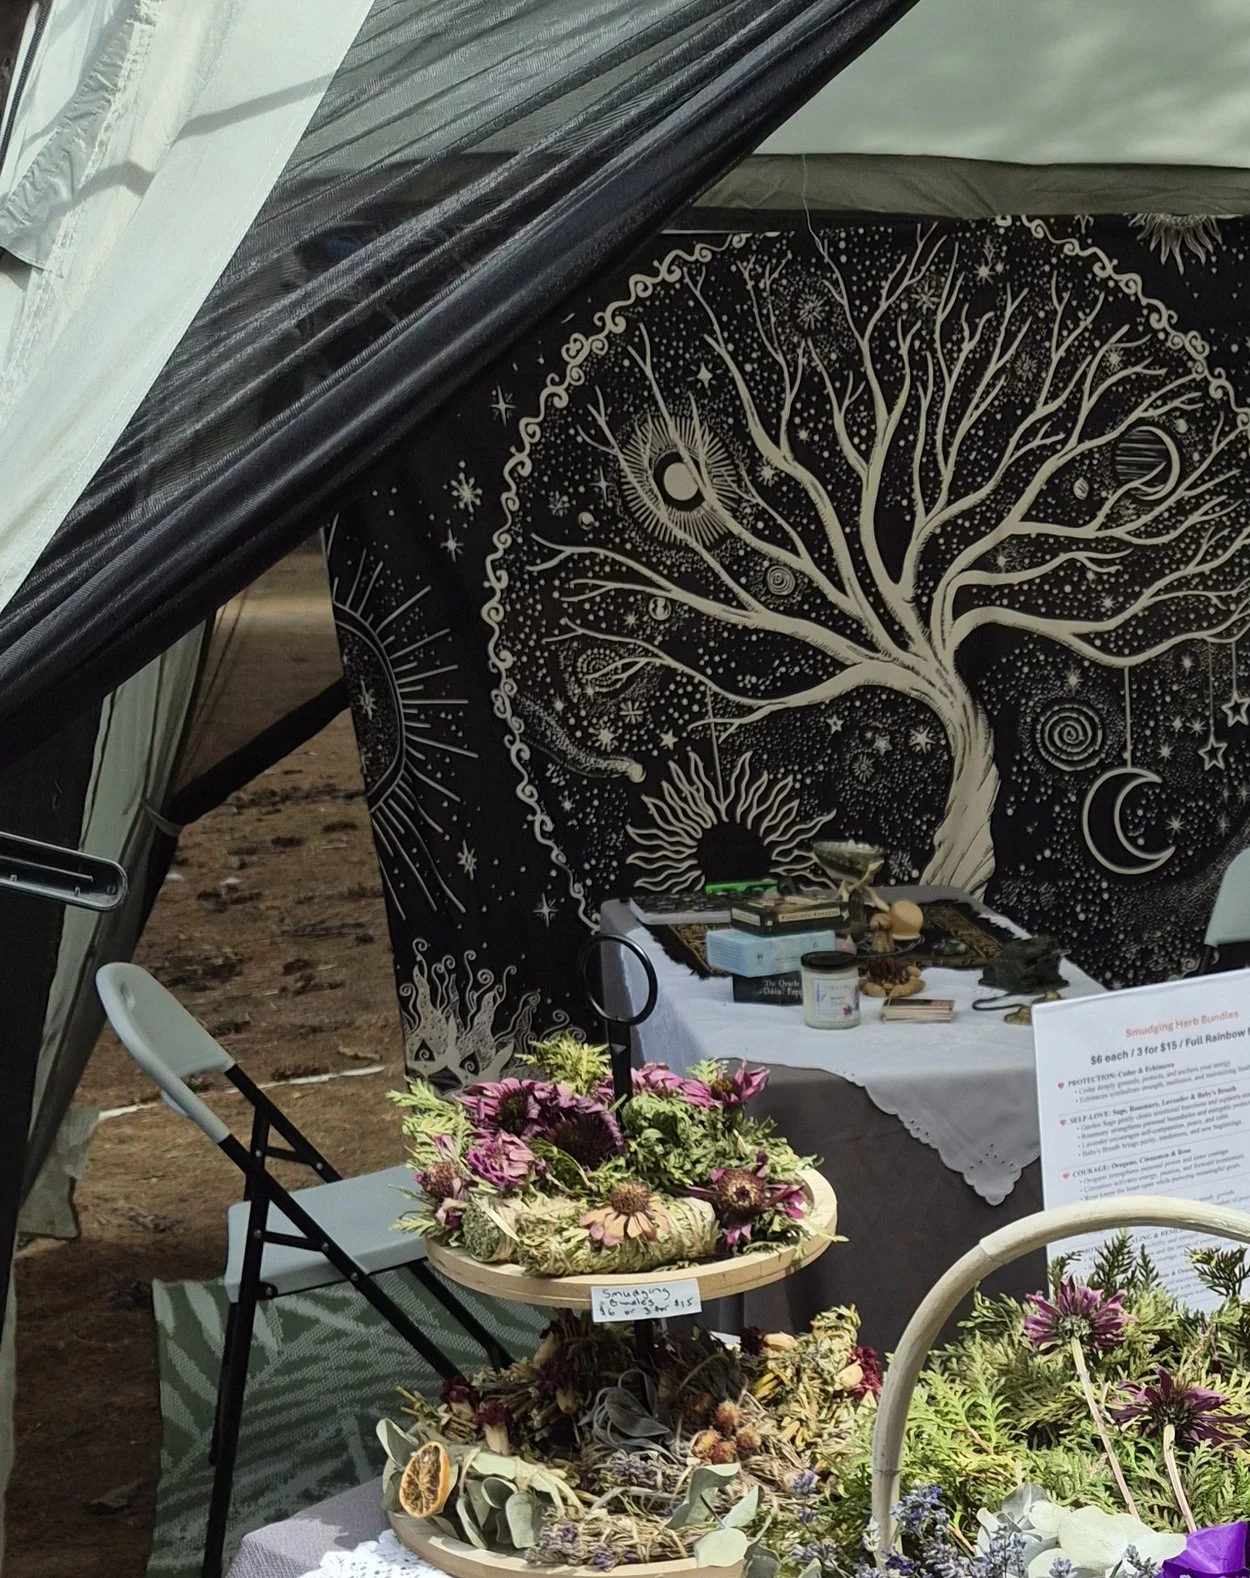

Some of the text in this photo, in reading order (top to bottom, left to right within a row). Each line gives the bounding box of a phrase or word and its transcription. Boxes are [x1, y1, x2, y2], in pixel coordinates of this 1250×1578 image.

[1125, 1010, 1239, 1038] Smudging Herb Bundles
[1090, 1054, 1103, 1066] $6
[1105, 1050, 1129, 1063] each
[1145, 1043, 1159, 1056] for
[1160, 1040, 1178, 1053] $15
[1185, 1034, 1203, 1048] Full
[1205, 1029, 1246, 1045] Rainbow
[603, 1287, 670, 1300] Smudging
